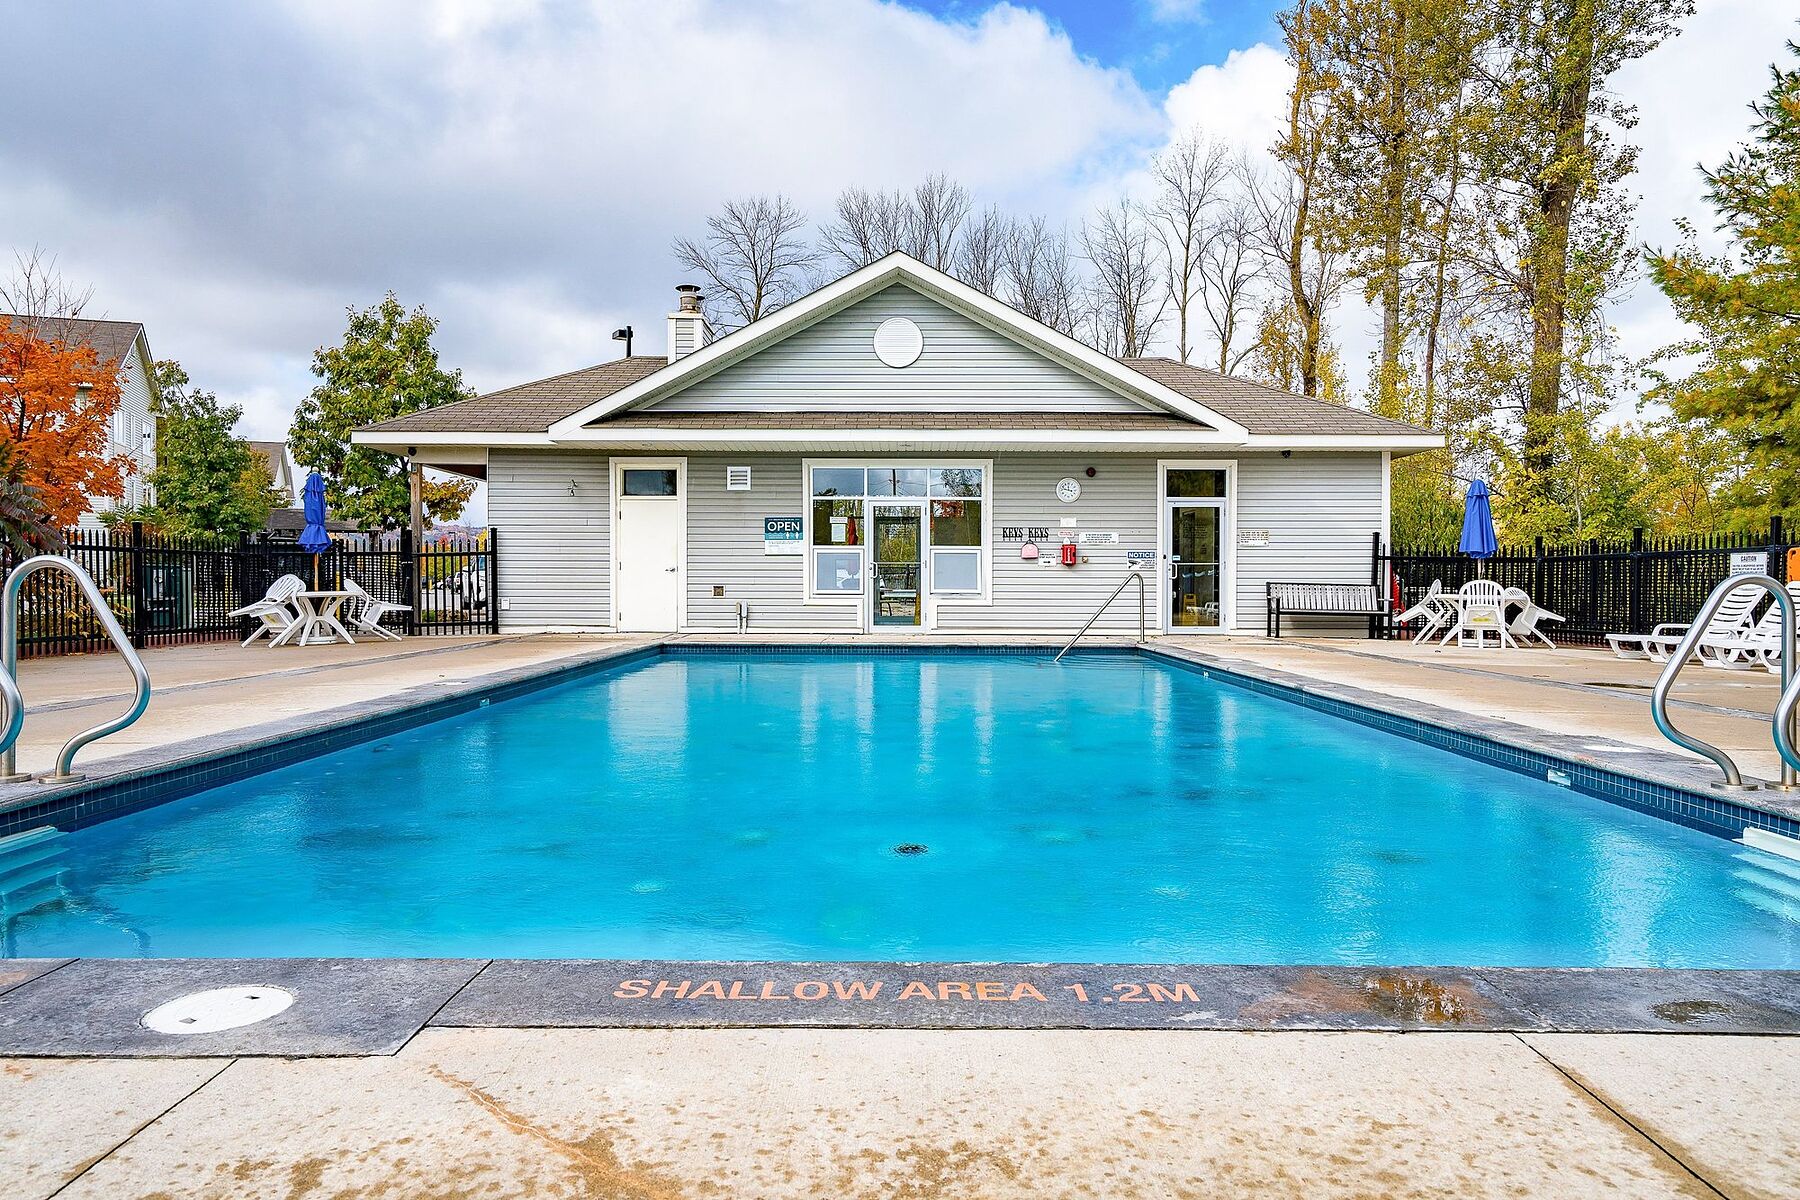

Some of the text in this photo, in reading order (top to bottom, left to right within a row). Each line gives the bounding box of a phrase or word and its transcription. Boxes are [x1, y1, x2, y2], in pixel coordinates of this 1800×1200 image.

[767, 521, 800, 531] OPEN
[1002, 527, 1023, 538] KEYS
[1028, 527, 1049, 538] KEYS
[612, 979, 1200, 1002] SHALLOW AREA 1.2M
